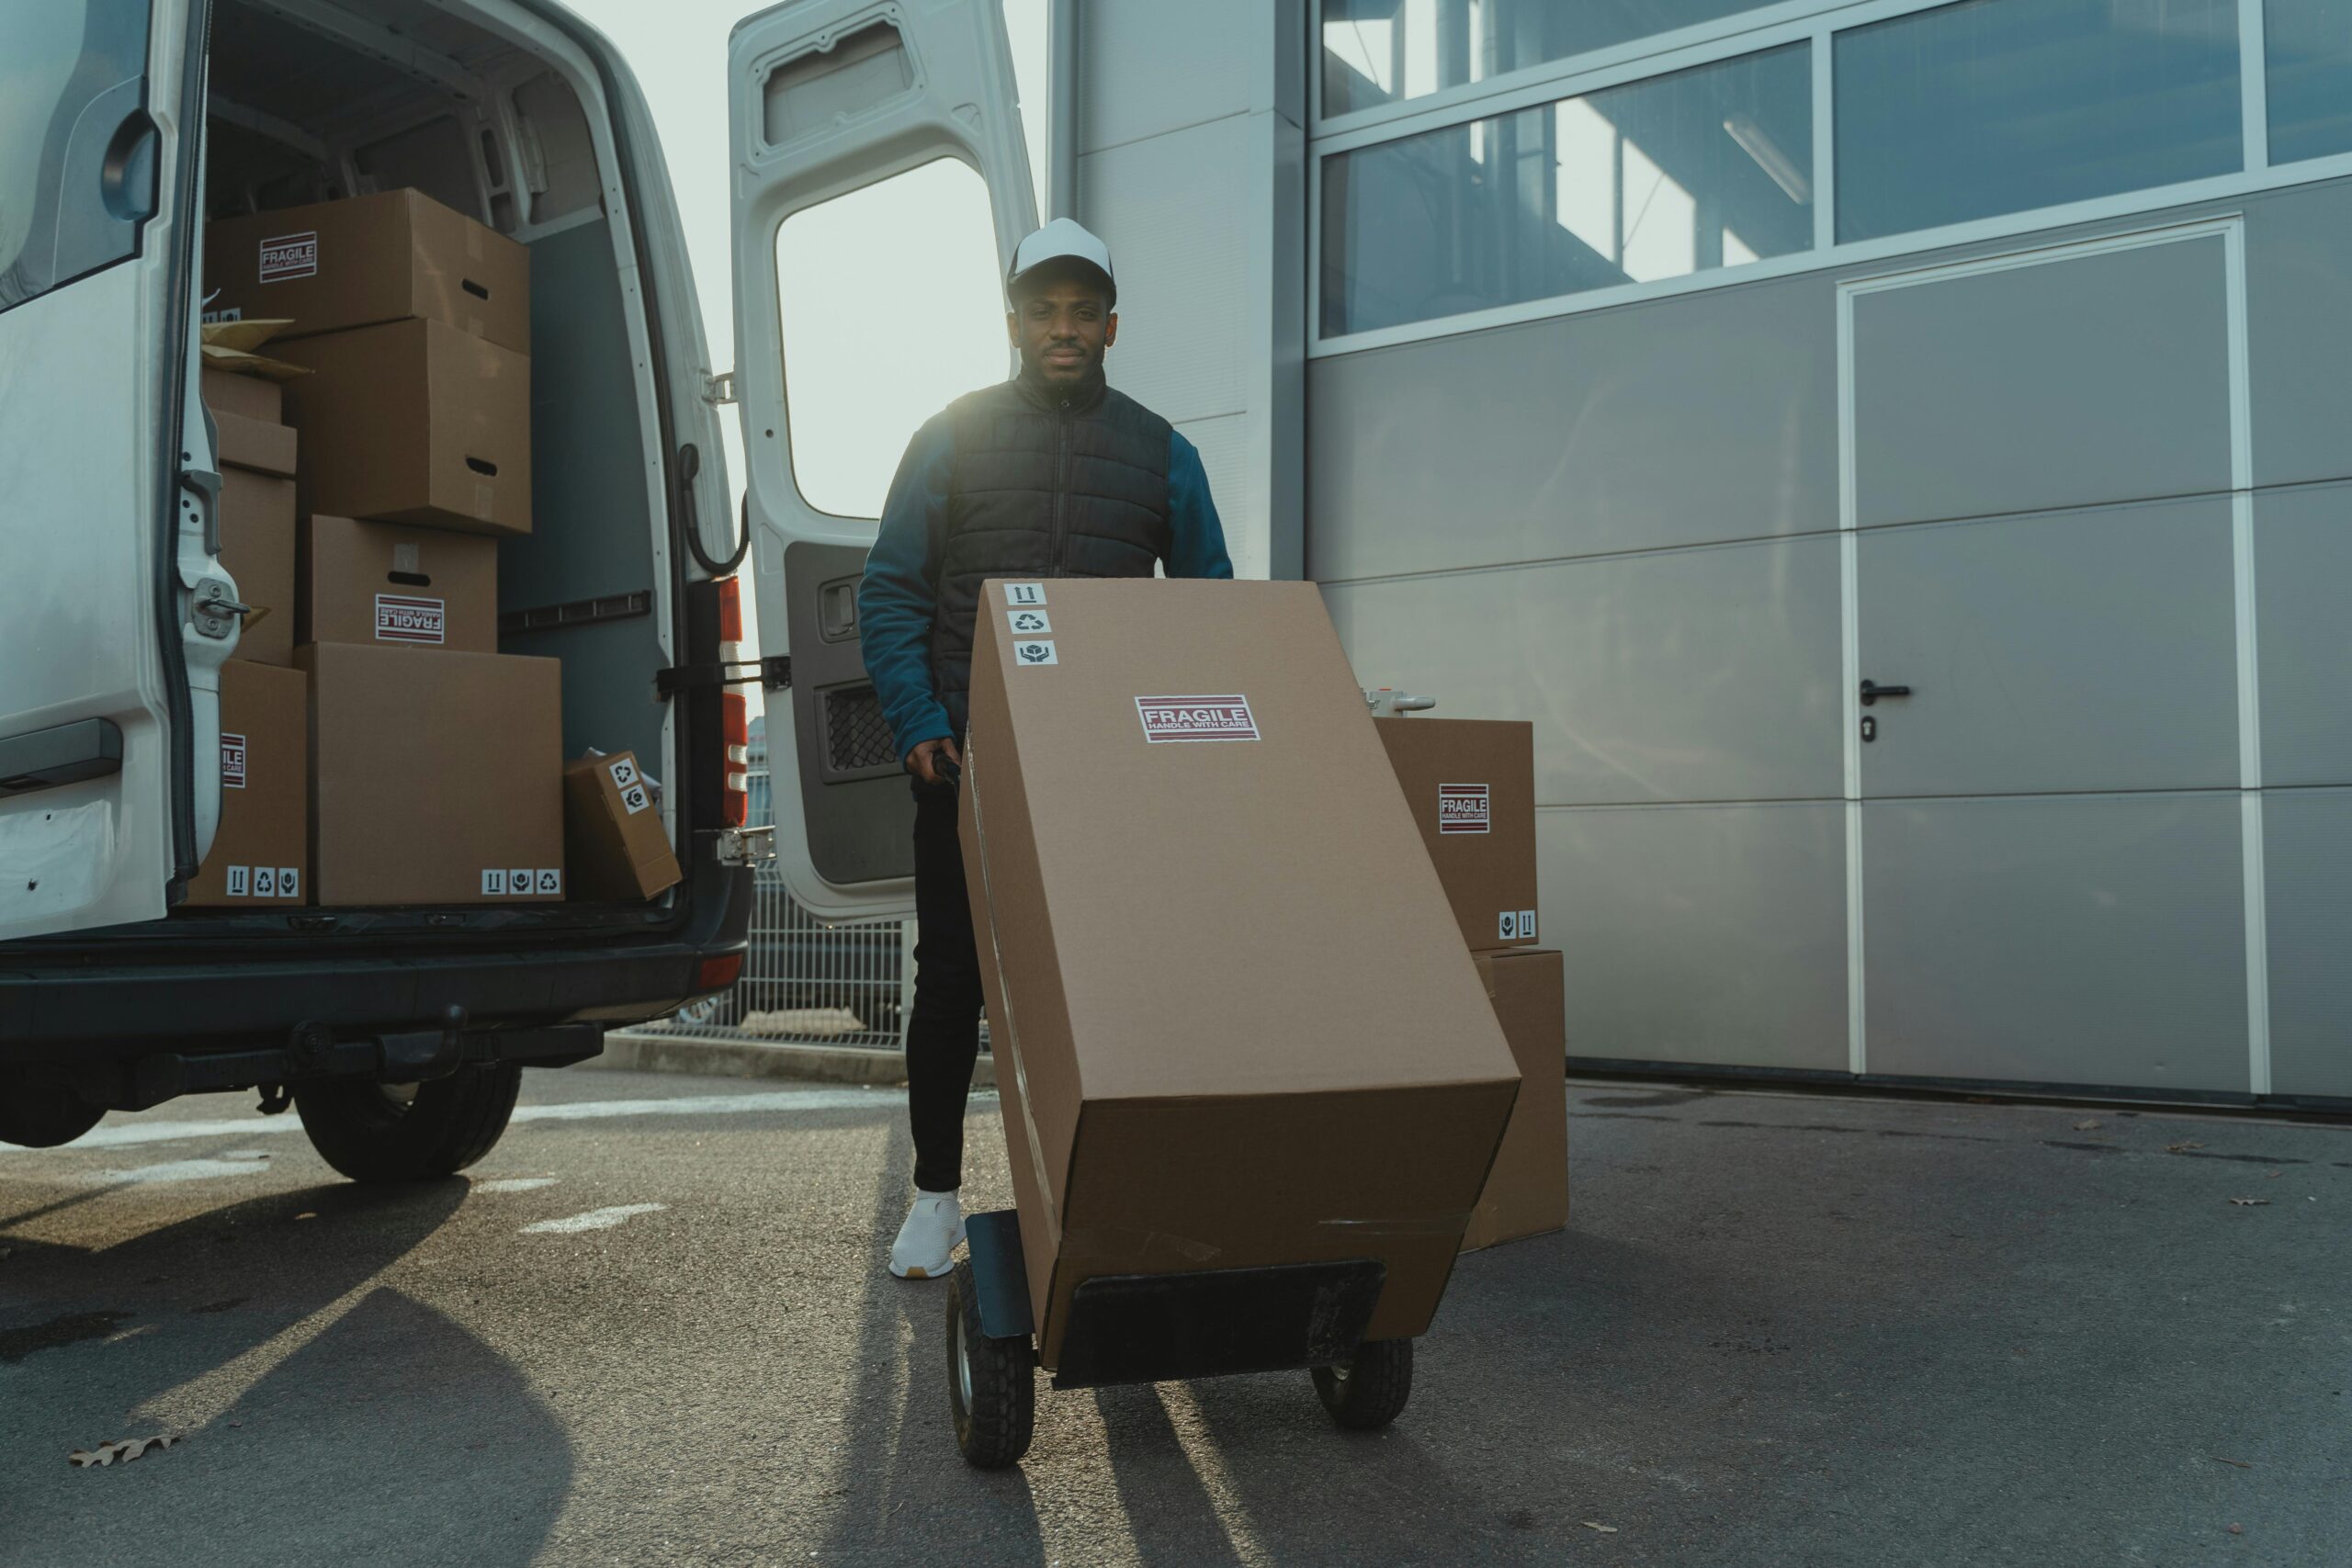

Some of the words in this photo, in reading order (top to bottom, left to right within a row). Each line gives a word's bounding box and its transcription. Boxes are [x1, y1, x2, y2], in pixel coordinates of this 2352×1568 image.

[263, 245, 313, 265] FRAGILE
[379, 614, 441, 630] FRAGILE
[1144, 709, 1248, 723] FRAGILE
[1442, 799, 1487, 812] FRAGILE
